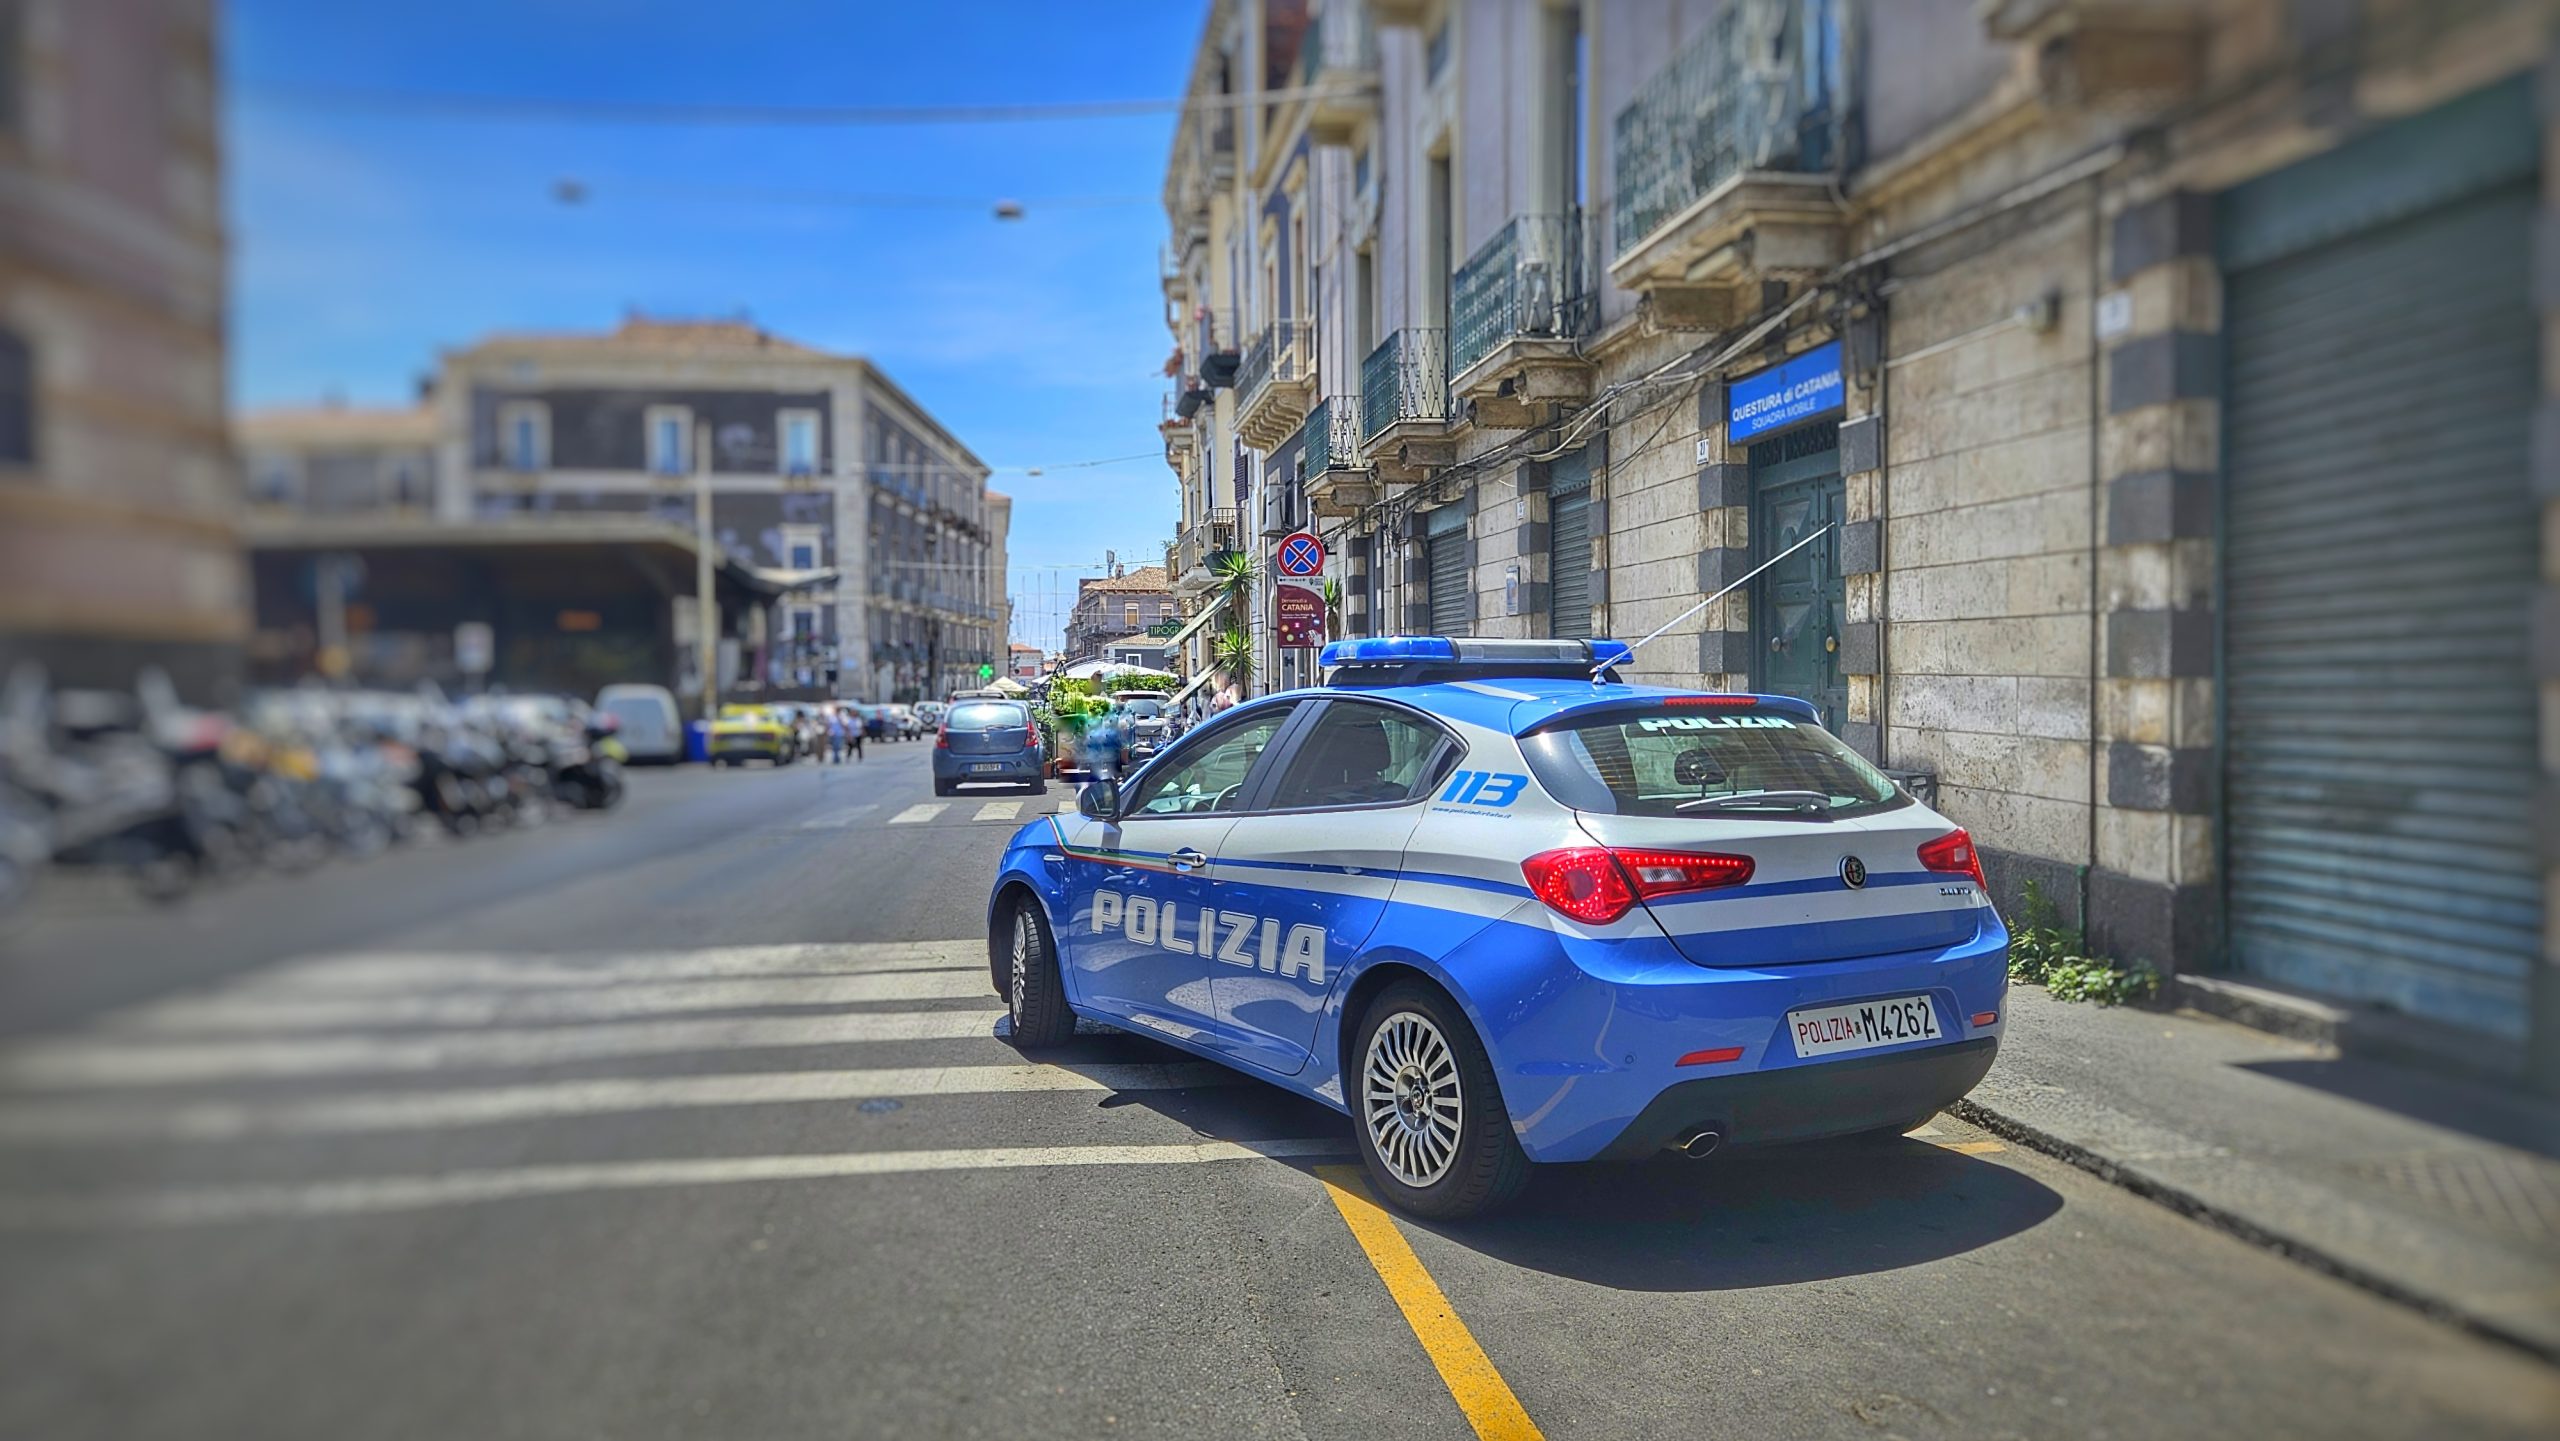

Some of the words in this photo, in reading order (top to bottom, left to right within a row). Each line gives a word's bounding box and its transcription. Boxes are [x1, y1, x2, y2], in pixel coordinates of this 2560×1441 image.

[1732, 393, 1783, 422] QUESTURA
[1783, 387, 1794, 404] di
[1794, 370, 1842, 399] CATANIA
[1751, 410, 1786, 430] SQUADRA
[1787, 397, 1816, 417] MOBILE
[1281, 603, 1314, 611] CATANIA
[1638, 716, 1796, 731] POLIZIA
[1439, 770, 1529, 808] 113
[1091, 888, 1326, 985] POLIZIA
[1797, 1016, 1855, 1046] POLIZIA
[1860, 1001, 1936, 1043] M4262
